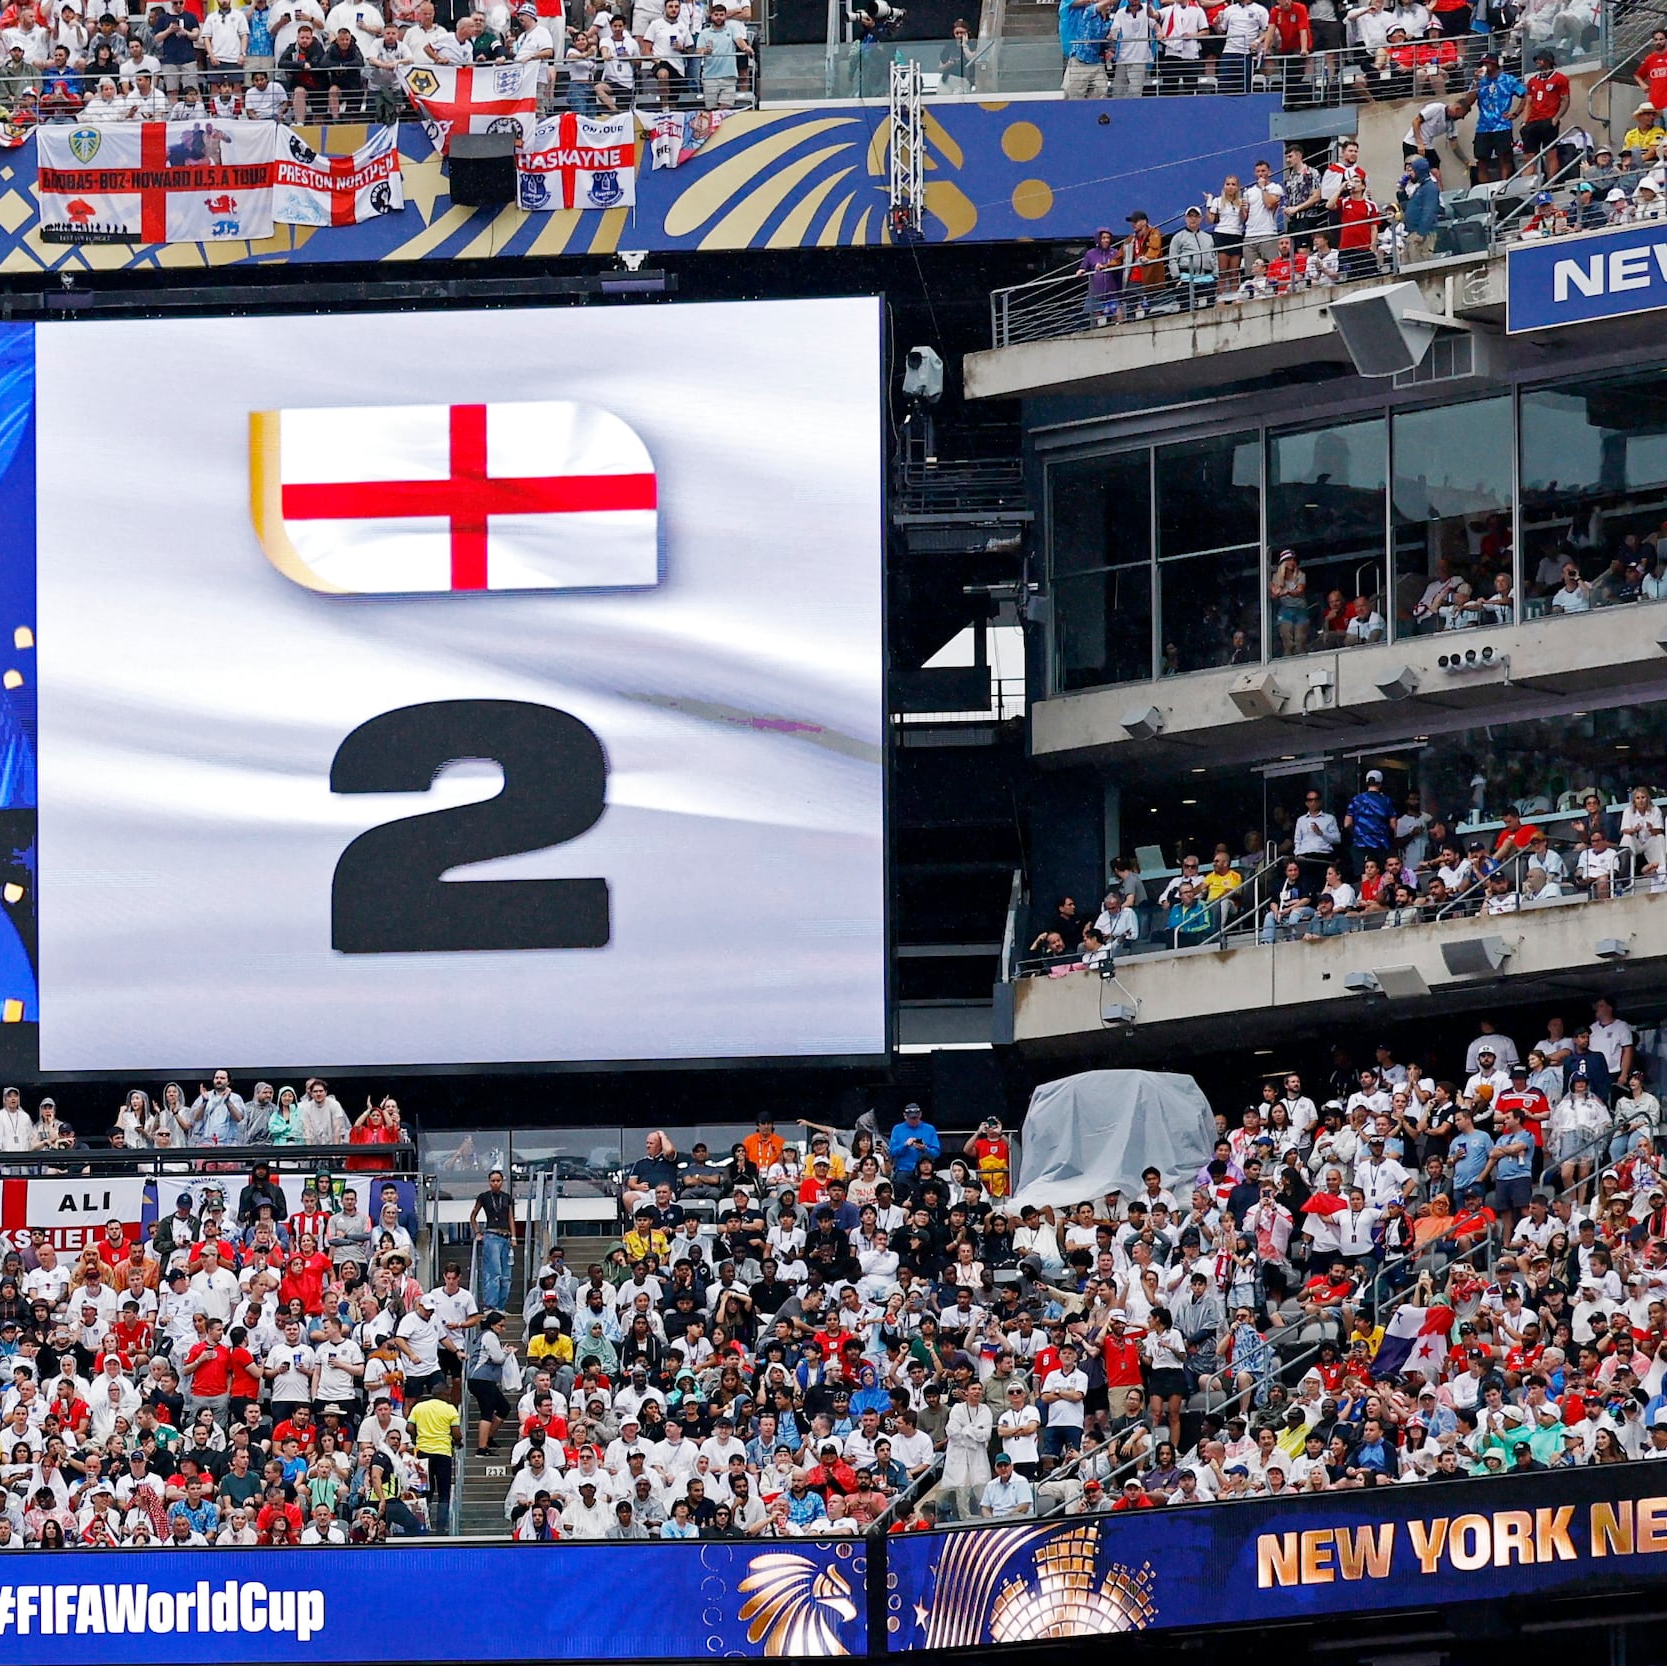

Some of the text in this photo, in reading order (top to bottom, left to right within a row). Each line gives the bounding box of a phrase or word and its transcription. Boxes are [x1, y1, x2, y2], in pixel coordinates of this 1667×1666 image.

[519, 149, 621, 169] HASKAYNE
[278, 166, 333, 188] PRESTON
[327, 698, 613, 952] 2
[58, 1191, 111, 1212] ALI
[487, 1467, 505, 1476] 232
[1257, 1524, 1396, 1589] NEW
[1408, 1504, 1584, 1576] YORK
